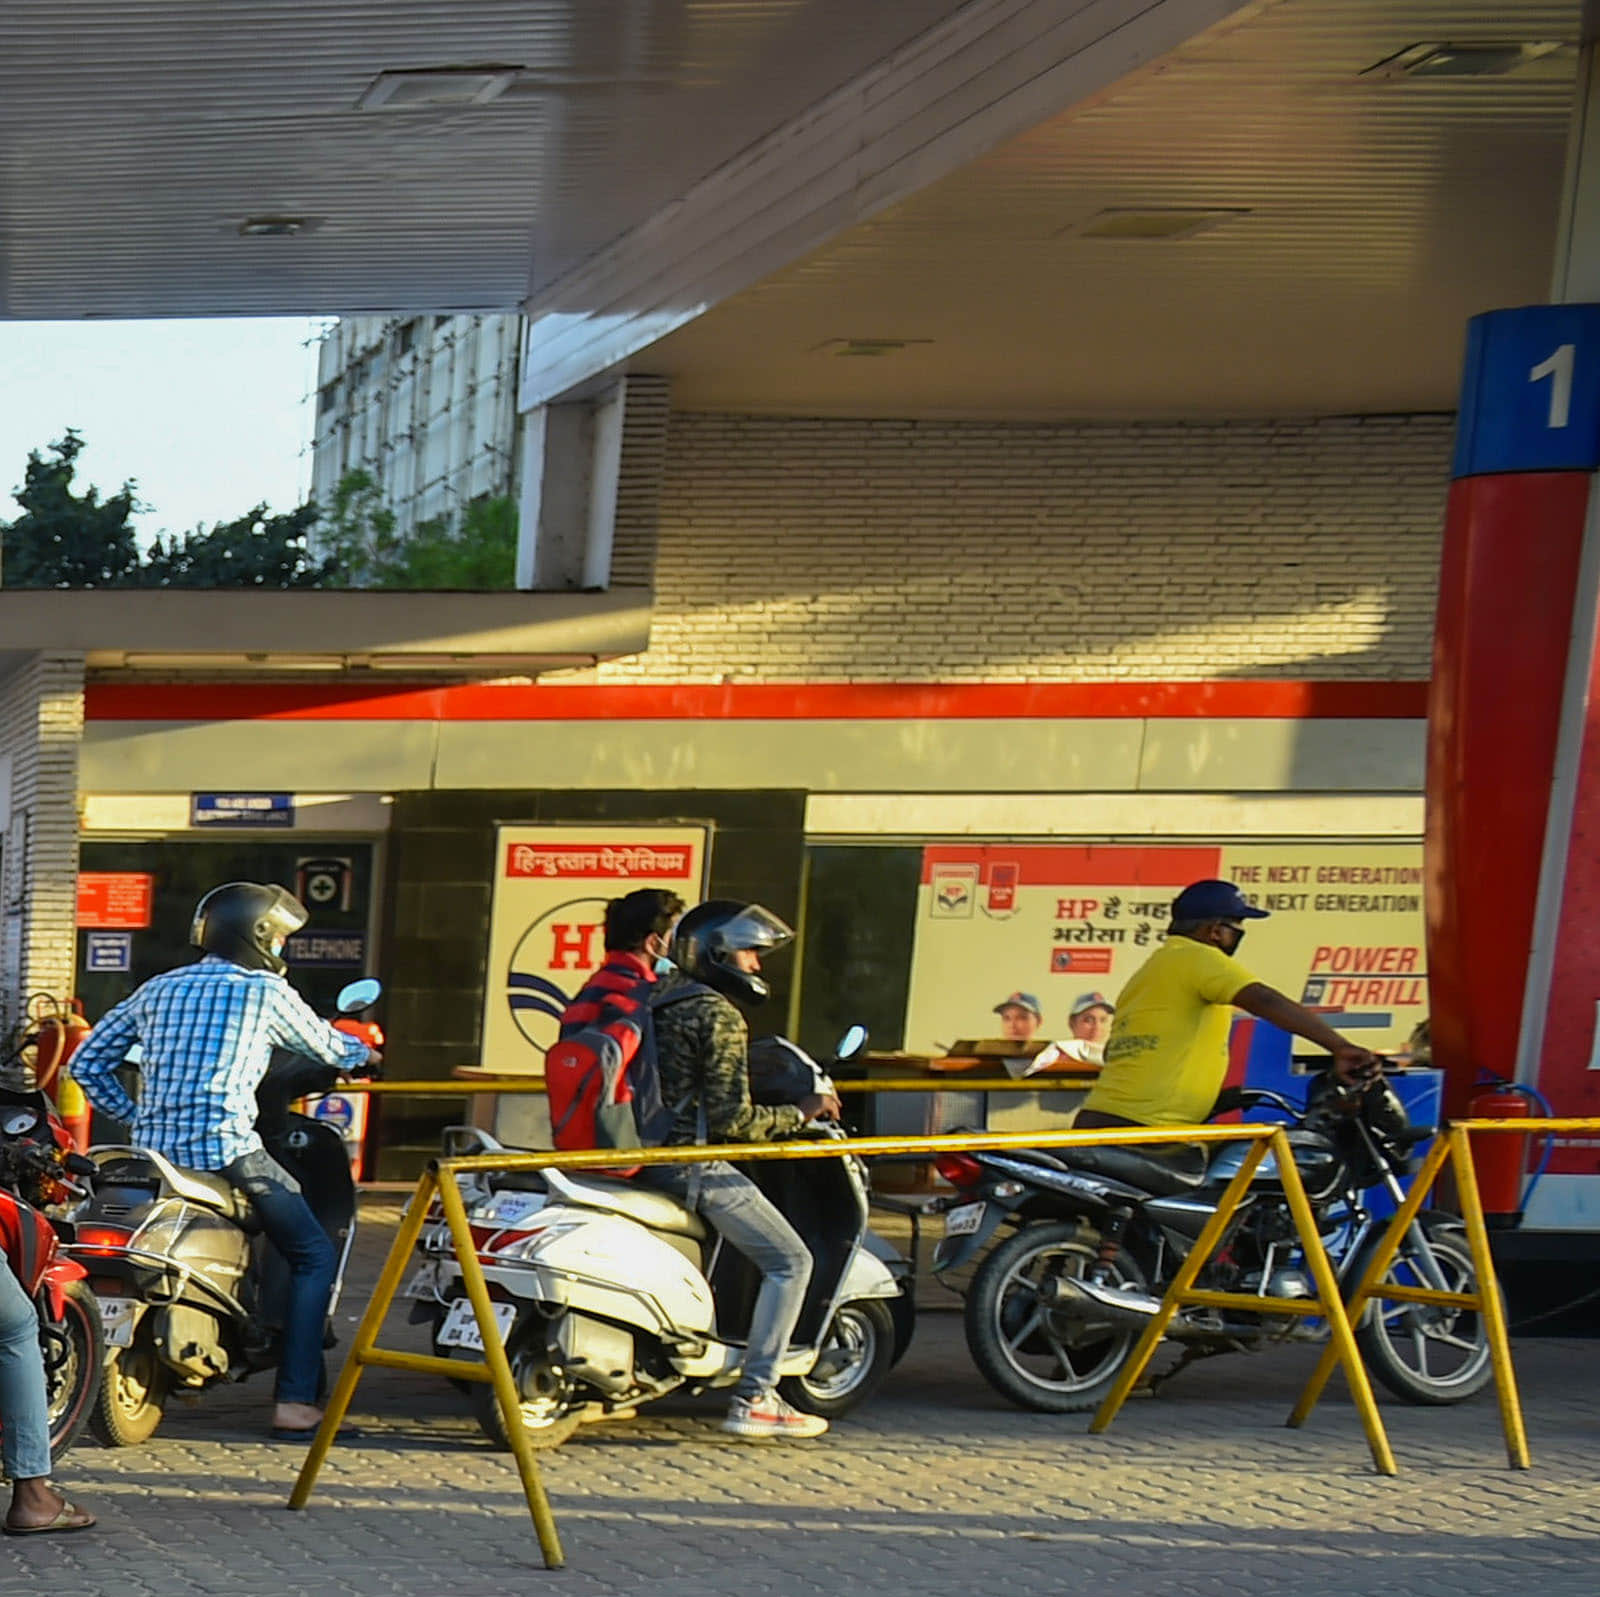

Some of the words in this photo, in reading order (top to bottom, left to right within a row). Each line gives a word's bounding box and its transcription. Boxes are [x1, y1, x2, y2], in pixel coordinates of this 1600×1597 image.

[1528, 344, 1576, 429] 1
[514, 846, 597, 875] हिन्दुस्तान
[601, 847, 684, 875] पेट्रोलियम
[1230, 866, 1262, 883] THE
[1267, 866, 1311, 883] NEXT
[1316, 866, 1424, 884] GENERATION
[1055, 898, 1099, 919] HP
[1103, 896, 1121, 919] है
[1264, 894, 1309, 911] NEXT
[1314, 894, 1419, 912] GENERATION
[1053, 921, 1125, 943] भरोसा
[1134, 923, 1151, 946] है
[289, 938, 362, 960] TELEPHONE
[548, 924, 606, 970] H
[1310, 946, 1419, 973] POWER
[1328, 979, 1423, 1006] THRILL
